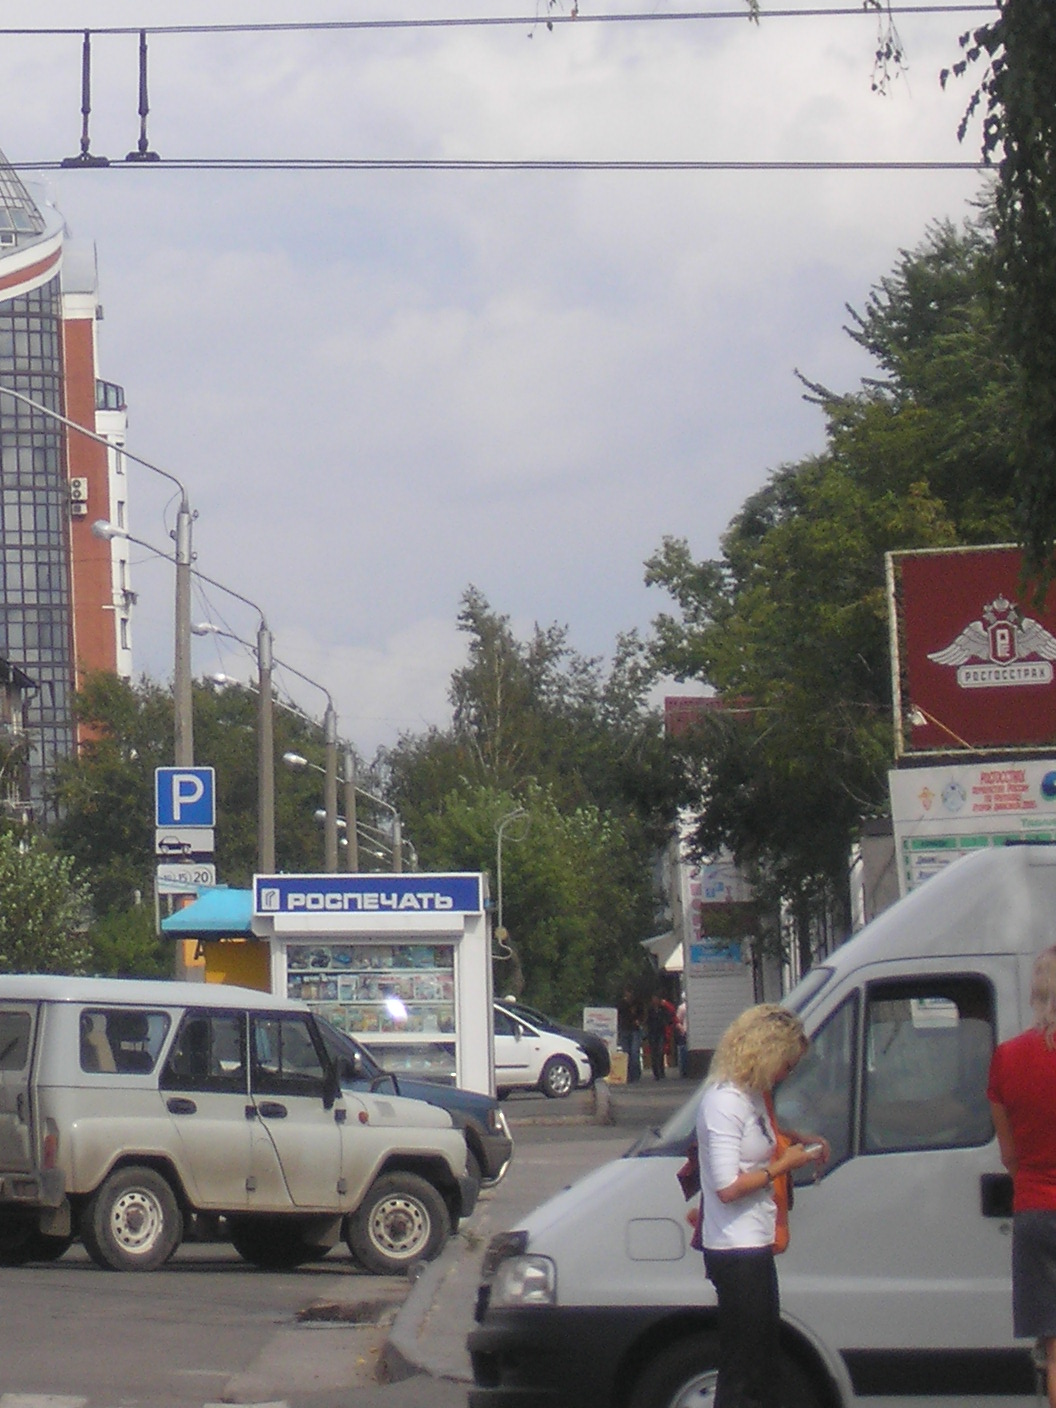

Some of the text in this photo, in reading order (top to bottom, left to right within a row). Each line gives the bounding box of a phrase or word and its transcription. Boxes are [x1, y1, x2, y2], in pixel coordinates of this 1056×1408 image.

[964, 668, 1045, 682] РОСГОССТРАХ
[172, 773, 204, 821] P
[193, 871, 209, 883] 20
[287, 892, 454, 910] РОСПЕЧАТЬ
